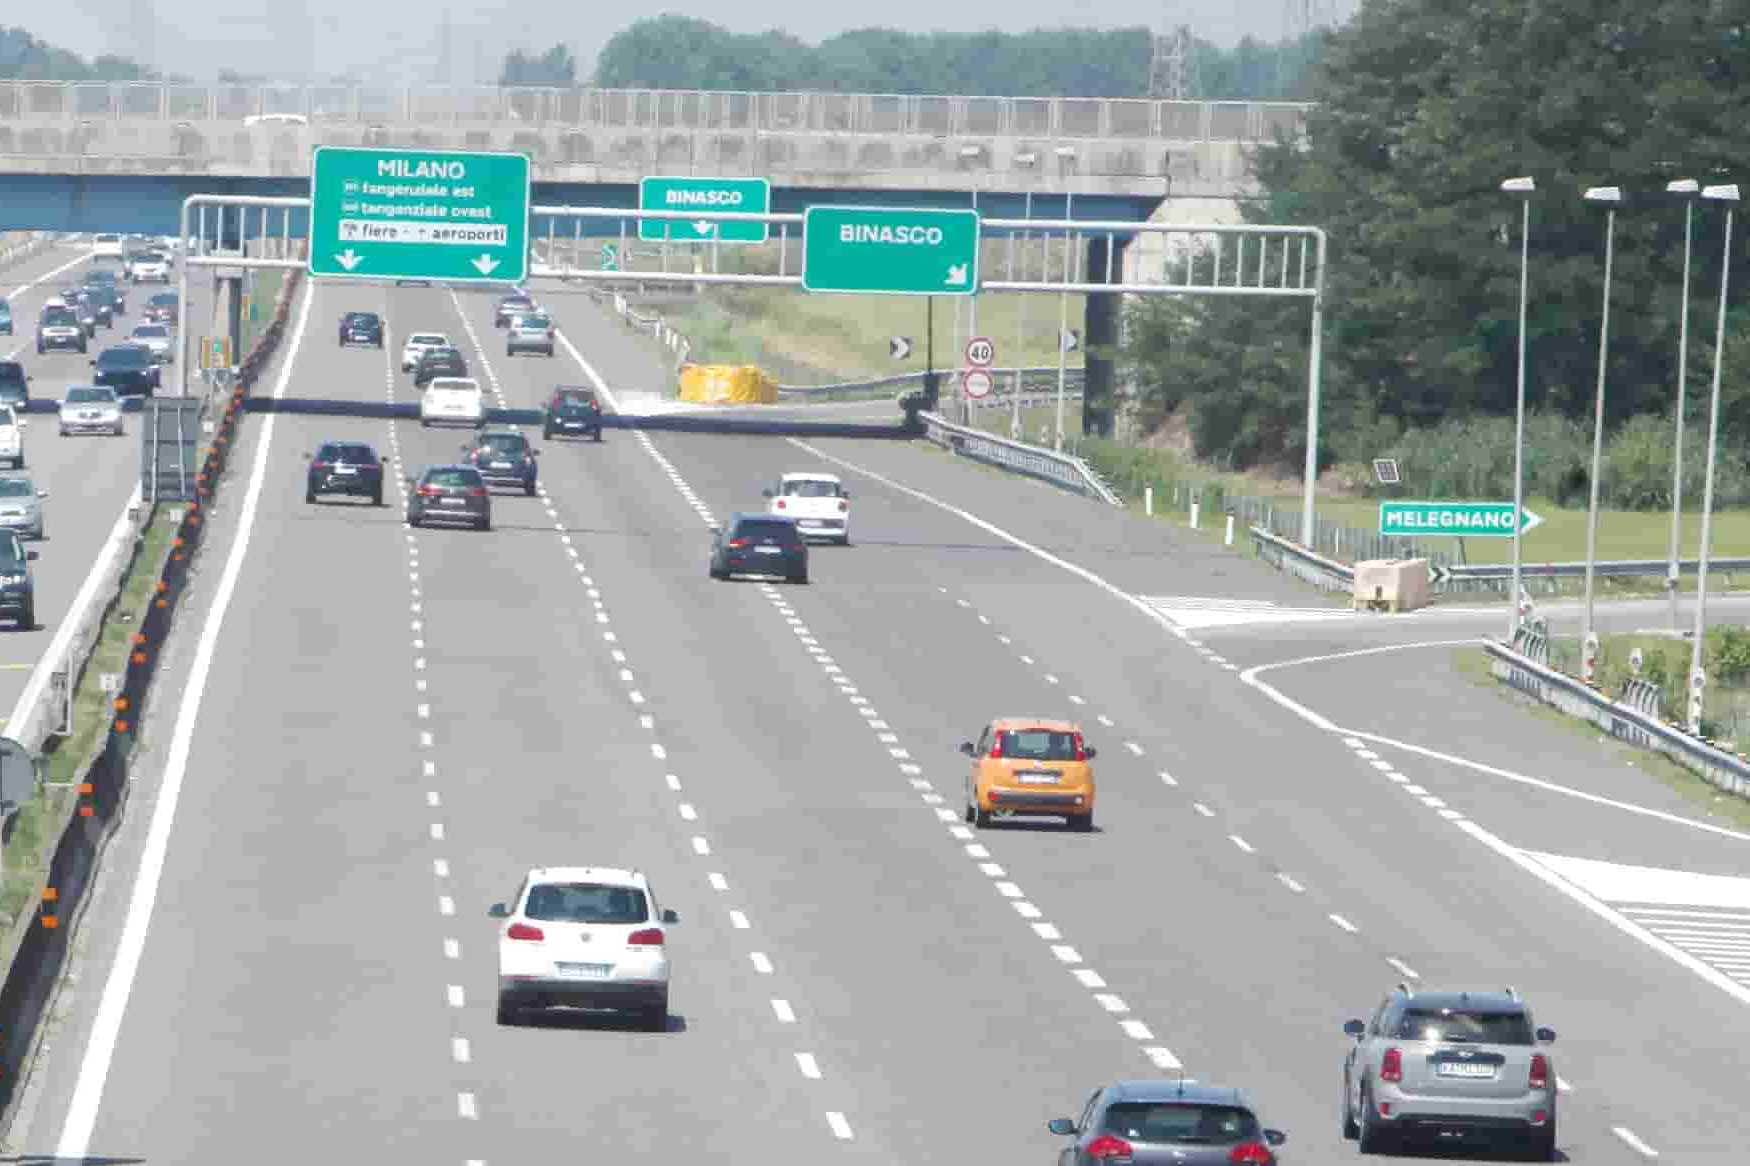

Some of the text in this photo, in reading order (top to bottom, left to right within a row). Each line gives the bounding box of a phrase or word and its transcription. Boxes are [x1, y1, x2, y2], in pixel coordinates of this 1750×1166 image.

[377, 159, 466, 179] MILANO
[361, 180, 448, 197] tangenziale
[665, 189, 743, 206] BINASCO
[361, 201, 448, 217] tangenziale
[839, 223, 944, 246] BINASCO
[971, 345, 990, 361] 40
[1386, 511, 1516, 528] MELEGNANO
